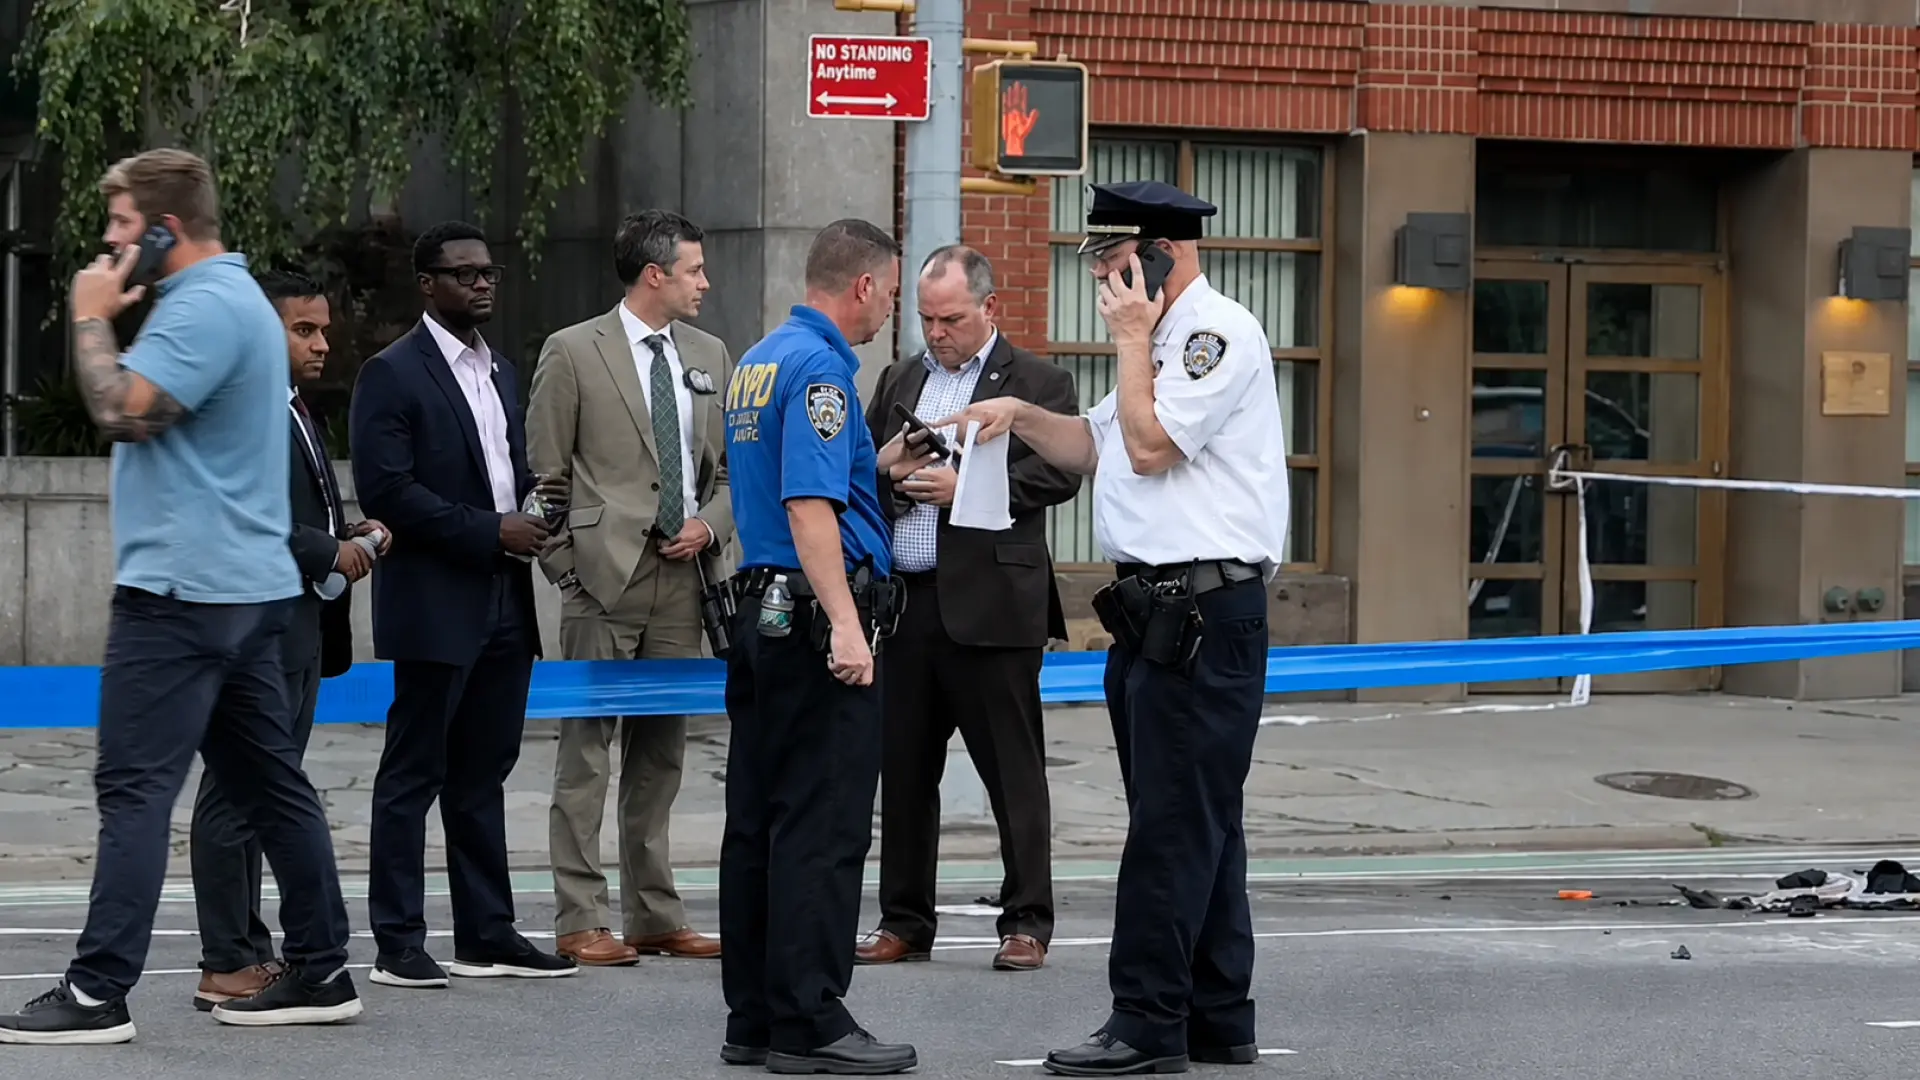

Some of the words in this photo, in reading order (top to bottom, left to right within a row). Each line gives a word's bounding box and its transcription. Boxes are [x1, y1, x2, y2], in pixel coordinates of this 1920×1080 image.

[816, 44, 836, 60] NO
[840, 44, 912, 62] STANDING
[816, 63, 877, 82] Anytime
[726, 363, 777, 412] NYPD
